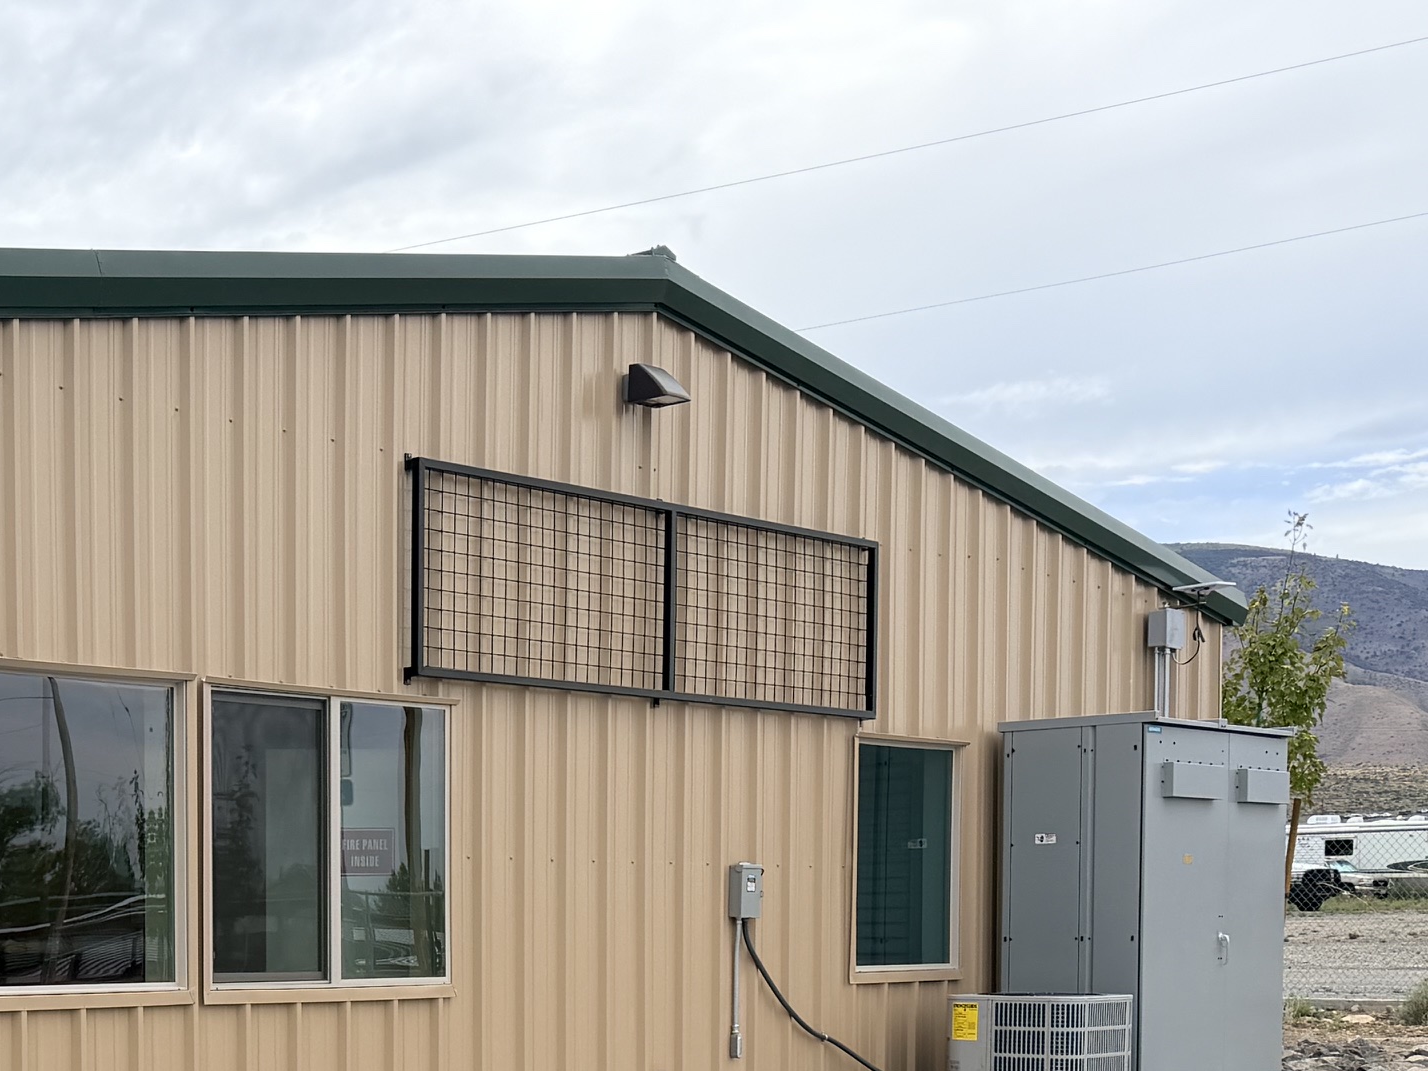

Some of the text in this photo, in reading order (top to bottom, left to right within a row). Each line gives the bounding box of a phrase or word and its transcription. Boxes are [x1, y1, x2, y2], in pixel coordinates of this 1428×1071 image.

[342, 838, 388, 850] FIRE PANEL
[351, 855, 379, 867] INSIDE
